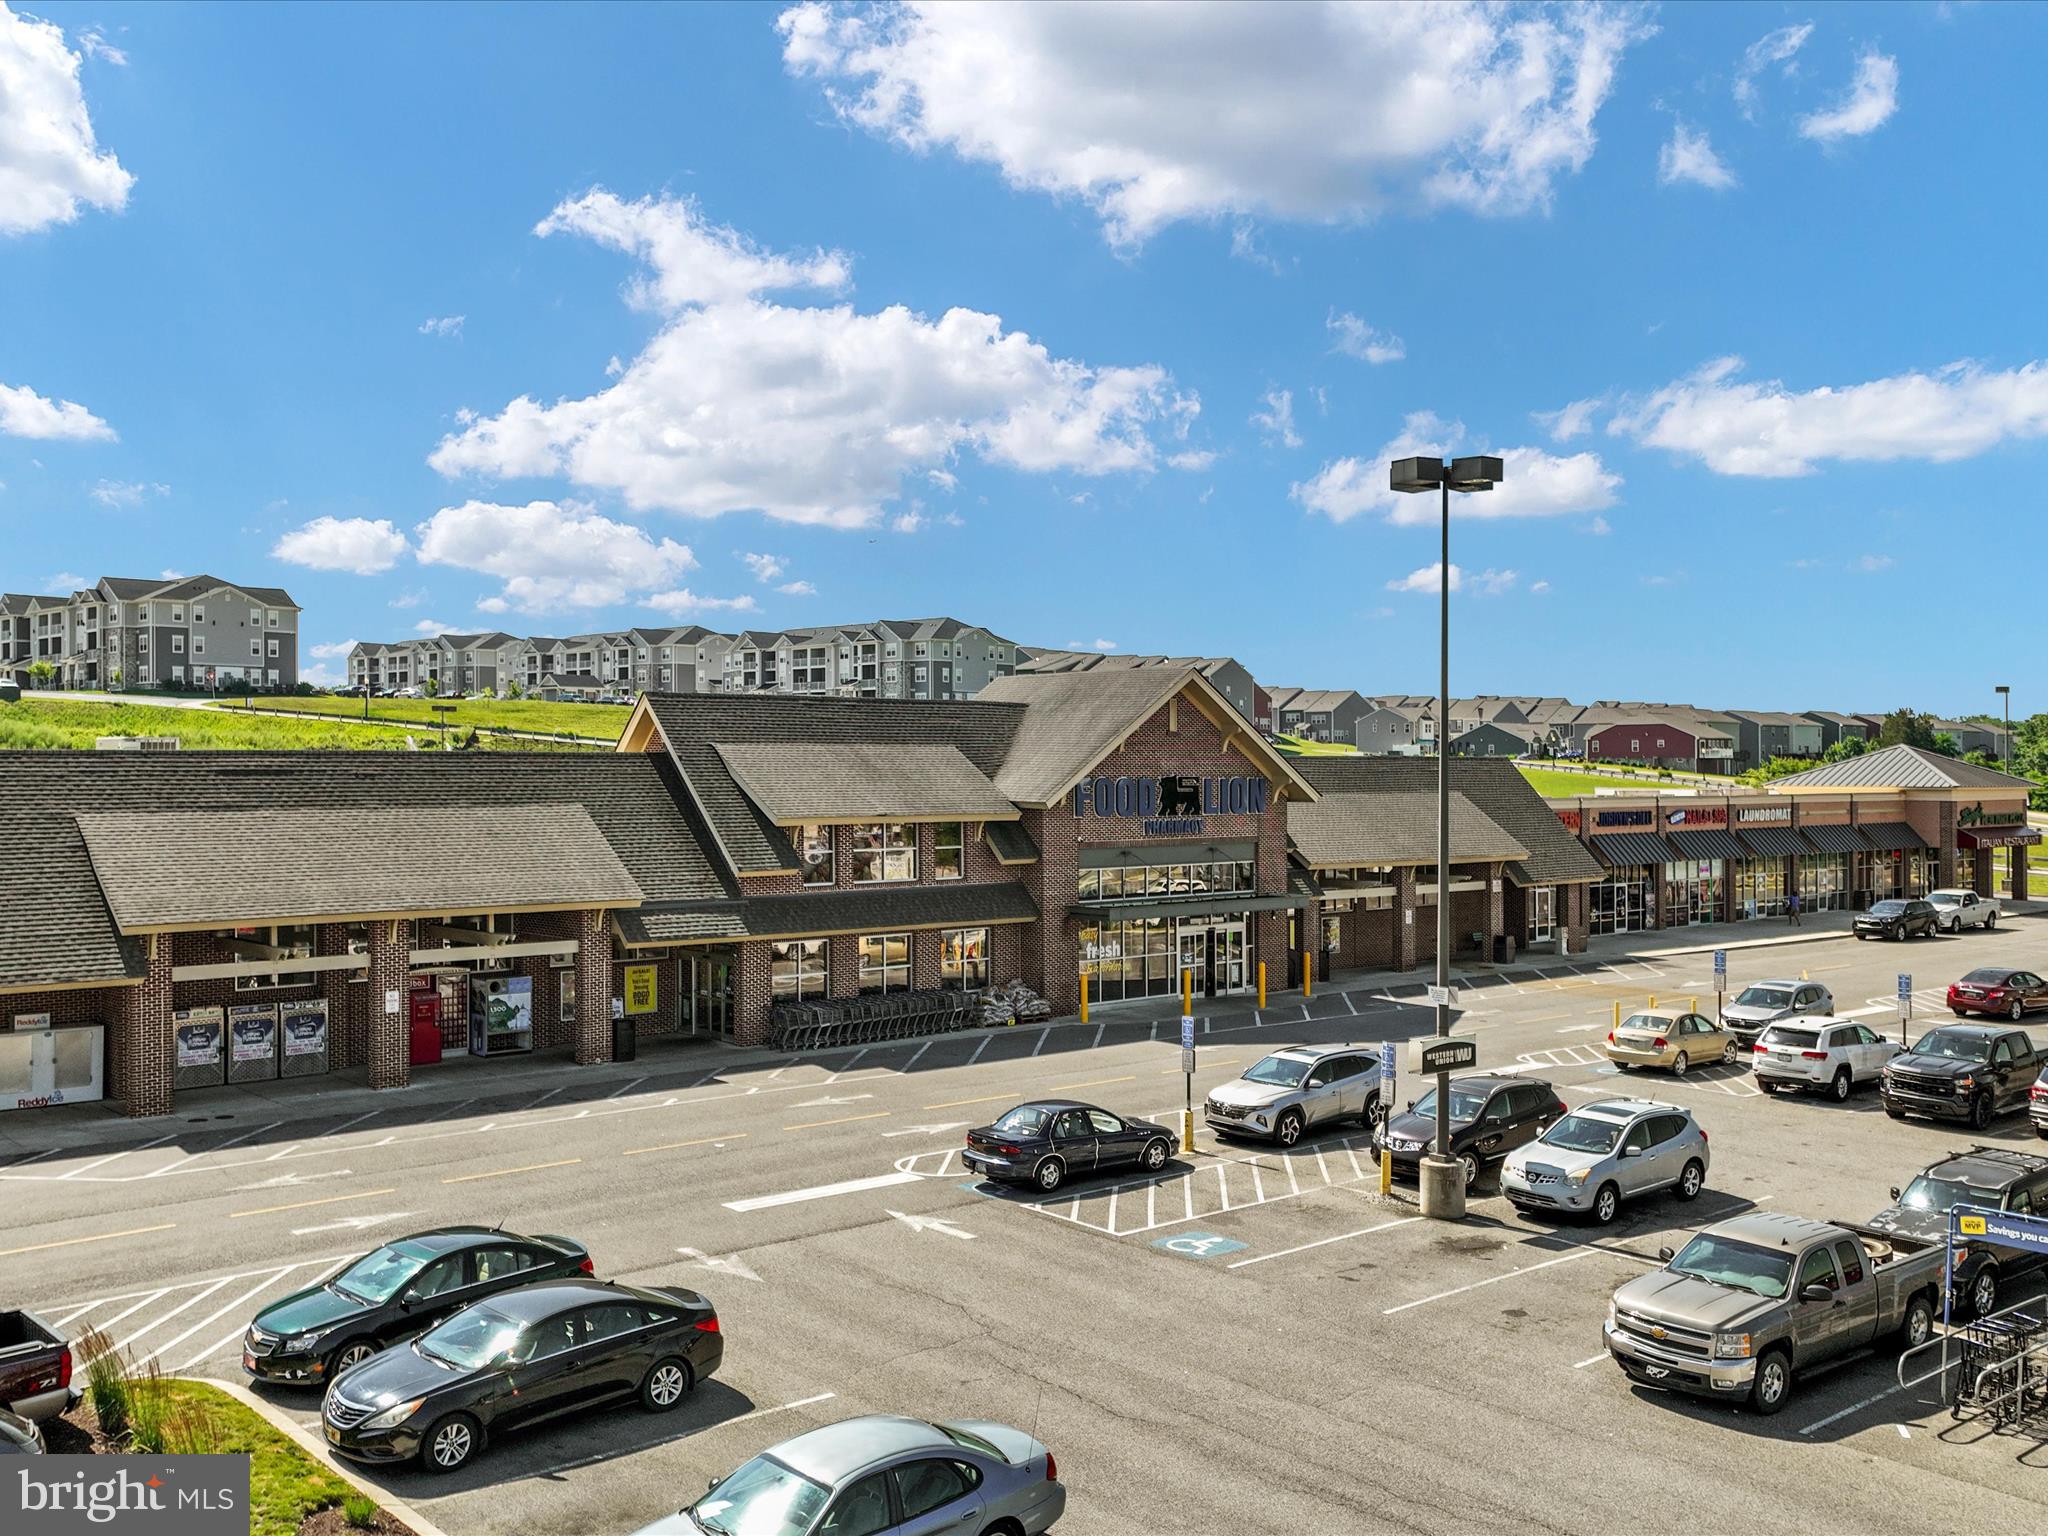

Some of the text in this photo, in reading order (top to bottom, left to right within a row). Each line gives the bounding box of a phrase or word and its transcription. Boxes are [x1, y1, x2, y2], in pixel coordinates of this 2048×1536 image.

[1073, 776, 1266, 818] FOOD LION
[1738, 807, 1791, 822] LAUNDROMAT
[1143, 819, 1204, 836] PHARMACY
[1981, 836, 2040, 849] ITALIAN RESTAURANT
[1086, 940, 1121, 959] fresh
[1426, 1049, 1454, 1060] WESTERN
[1435, 1056, 1454, 1066] UNION
[1987, 1223, 2020, 1239] Savings
[2021, 1231, 2038, 1242] you
